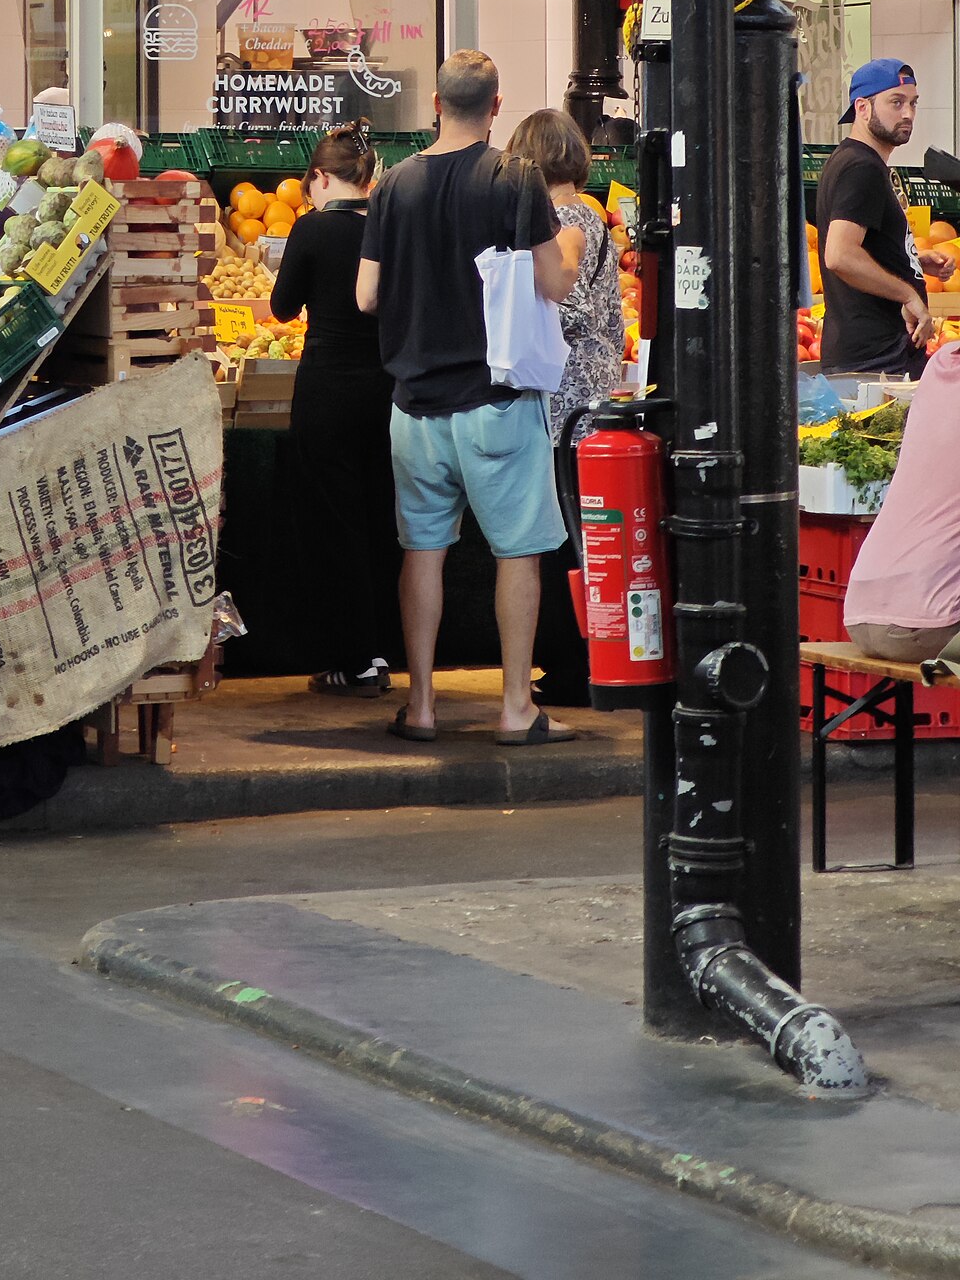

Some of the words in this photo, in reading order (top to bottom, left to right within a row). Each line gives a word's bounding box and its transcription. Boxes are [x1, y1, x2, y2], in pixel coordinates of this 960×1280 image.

[245, 38, 294, 51] Cheddar
[214, 74, 335, 92] HOMEMADE
[206, 96, 344, 114] CURRYWURST
[97, 202, 116, 224] FRUTTI
[58, 256, 77, 277] FRUTTI
[32, 475, 57, 520] VARIETY:
[14, 485, 39, 533] PROCESS:
[28, 532, 49, 572] Washed
[70, 457, 94, 499] REGION:
[107, 582, 125, 611] Cauca
[93, 448, 121, 503] PRODUCER:
[122, 560, 146, 593] Aguila
[134, 469, 157, 509] RAW
[148, 512, 180, 603] MATERIAL
[52, 661, 68, 676] NO
[65, 644, 101, 669] HOOKS
[103, 634, 121, 650] NO
